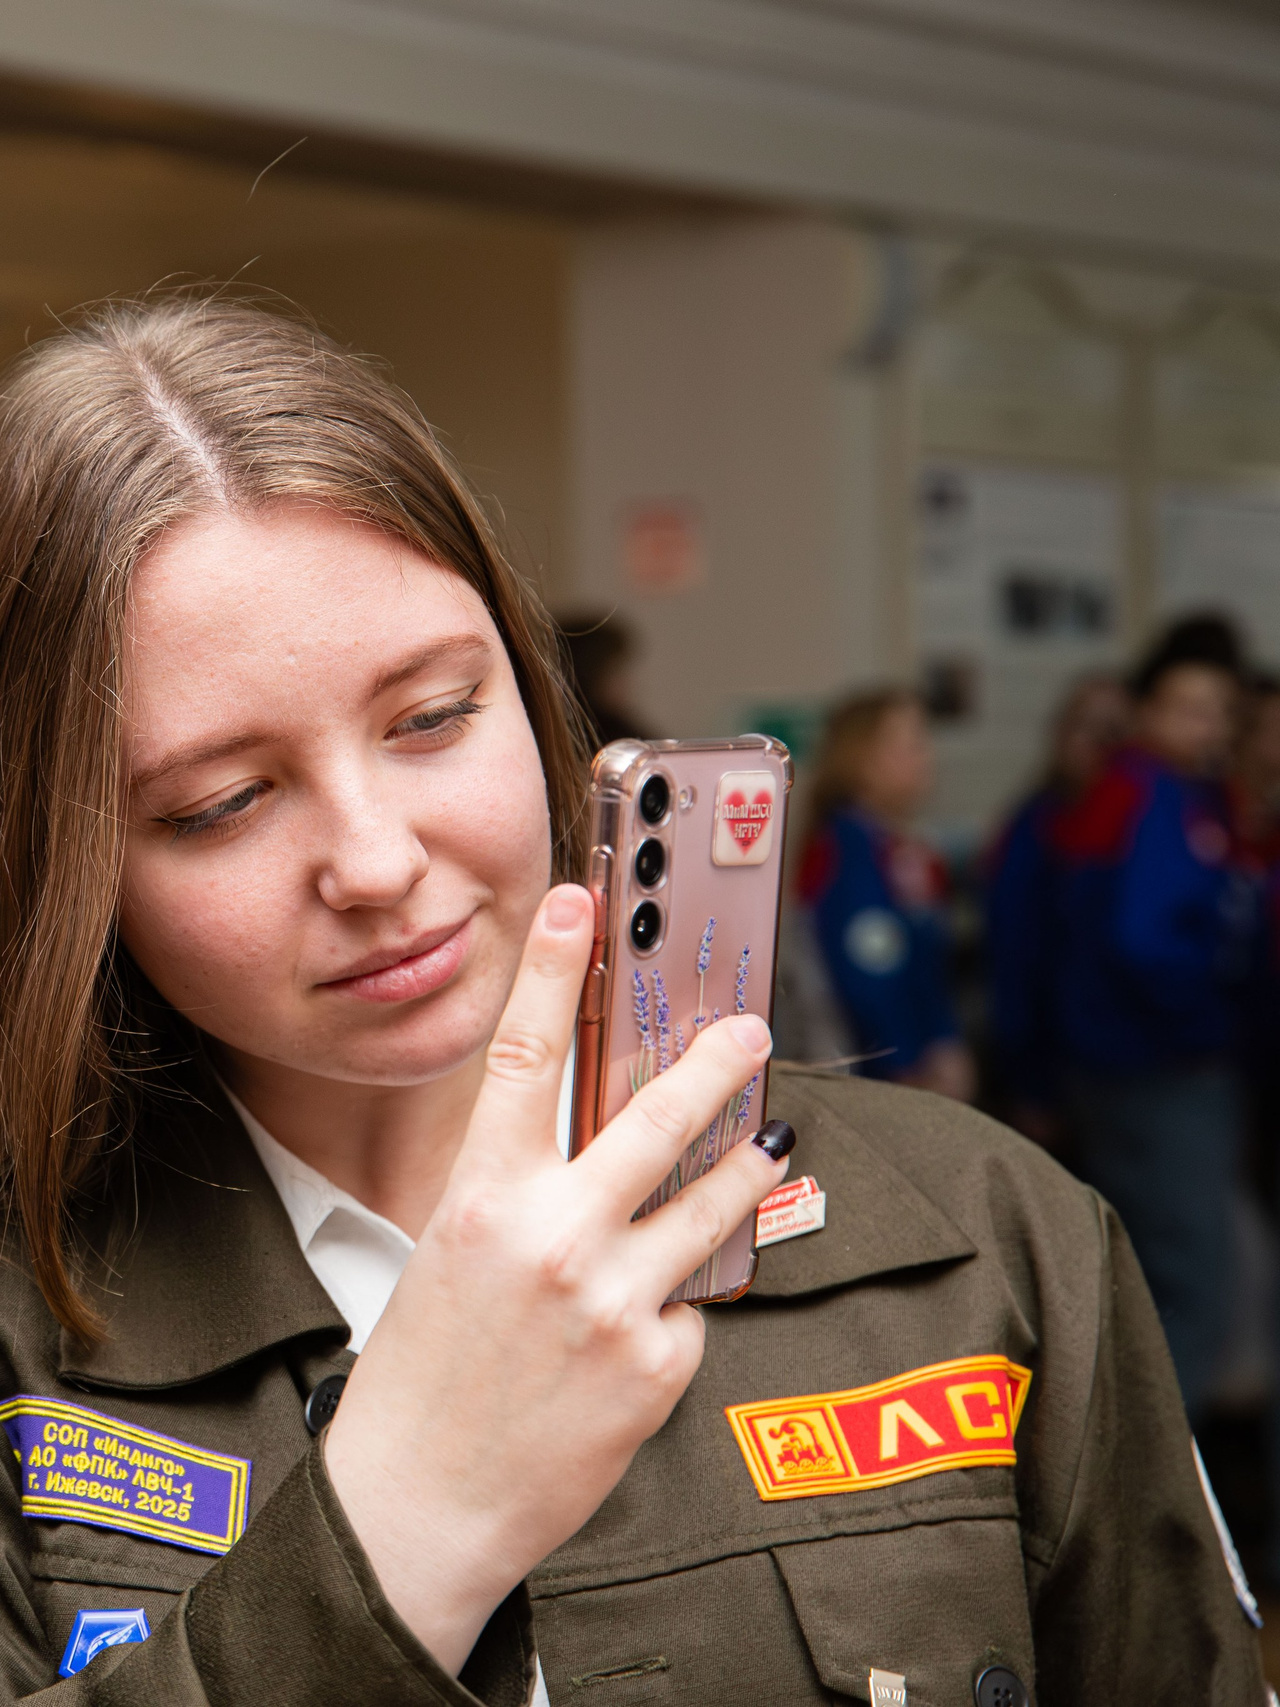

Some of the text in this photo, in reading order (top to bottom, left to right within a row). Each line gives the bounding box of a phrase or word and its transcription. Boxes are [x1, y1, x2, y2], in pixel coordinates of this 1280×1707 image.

[878, 1381, 1014, 1461] ЛС
[28, 1445, 195, 1501] АО «ФПК» ЛВЧ-1
[43, 1422, 186, 1477] СОП «Индиго»
[28, 1471, 192, 1522] г. Ижевск, 2025
